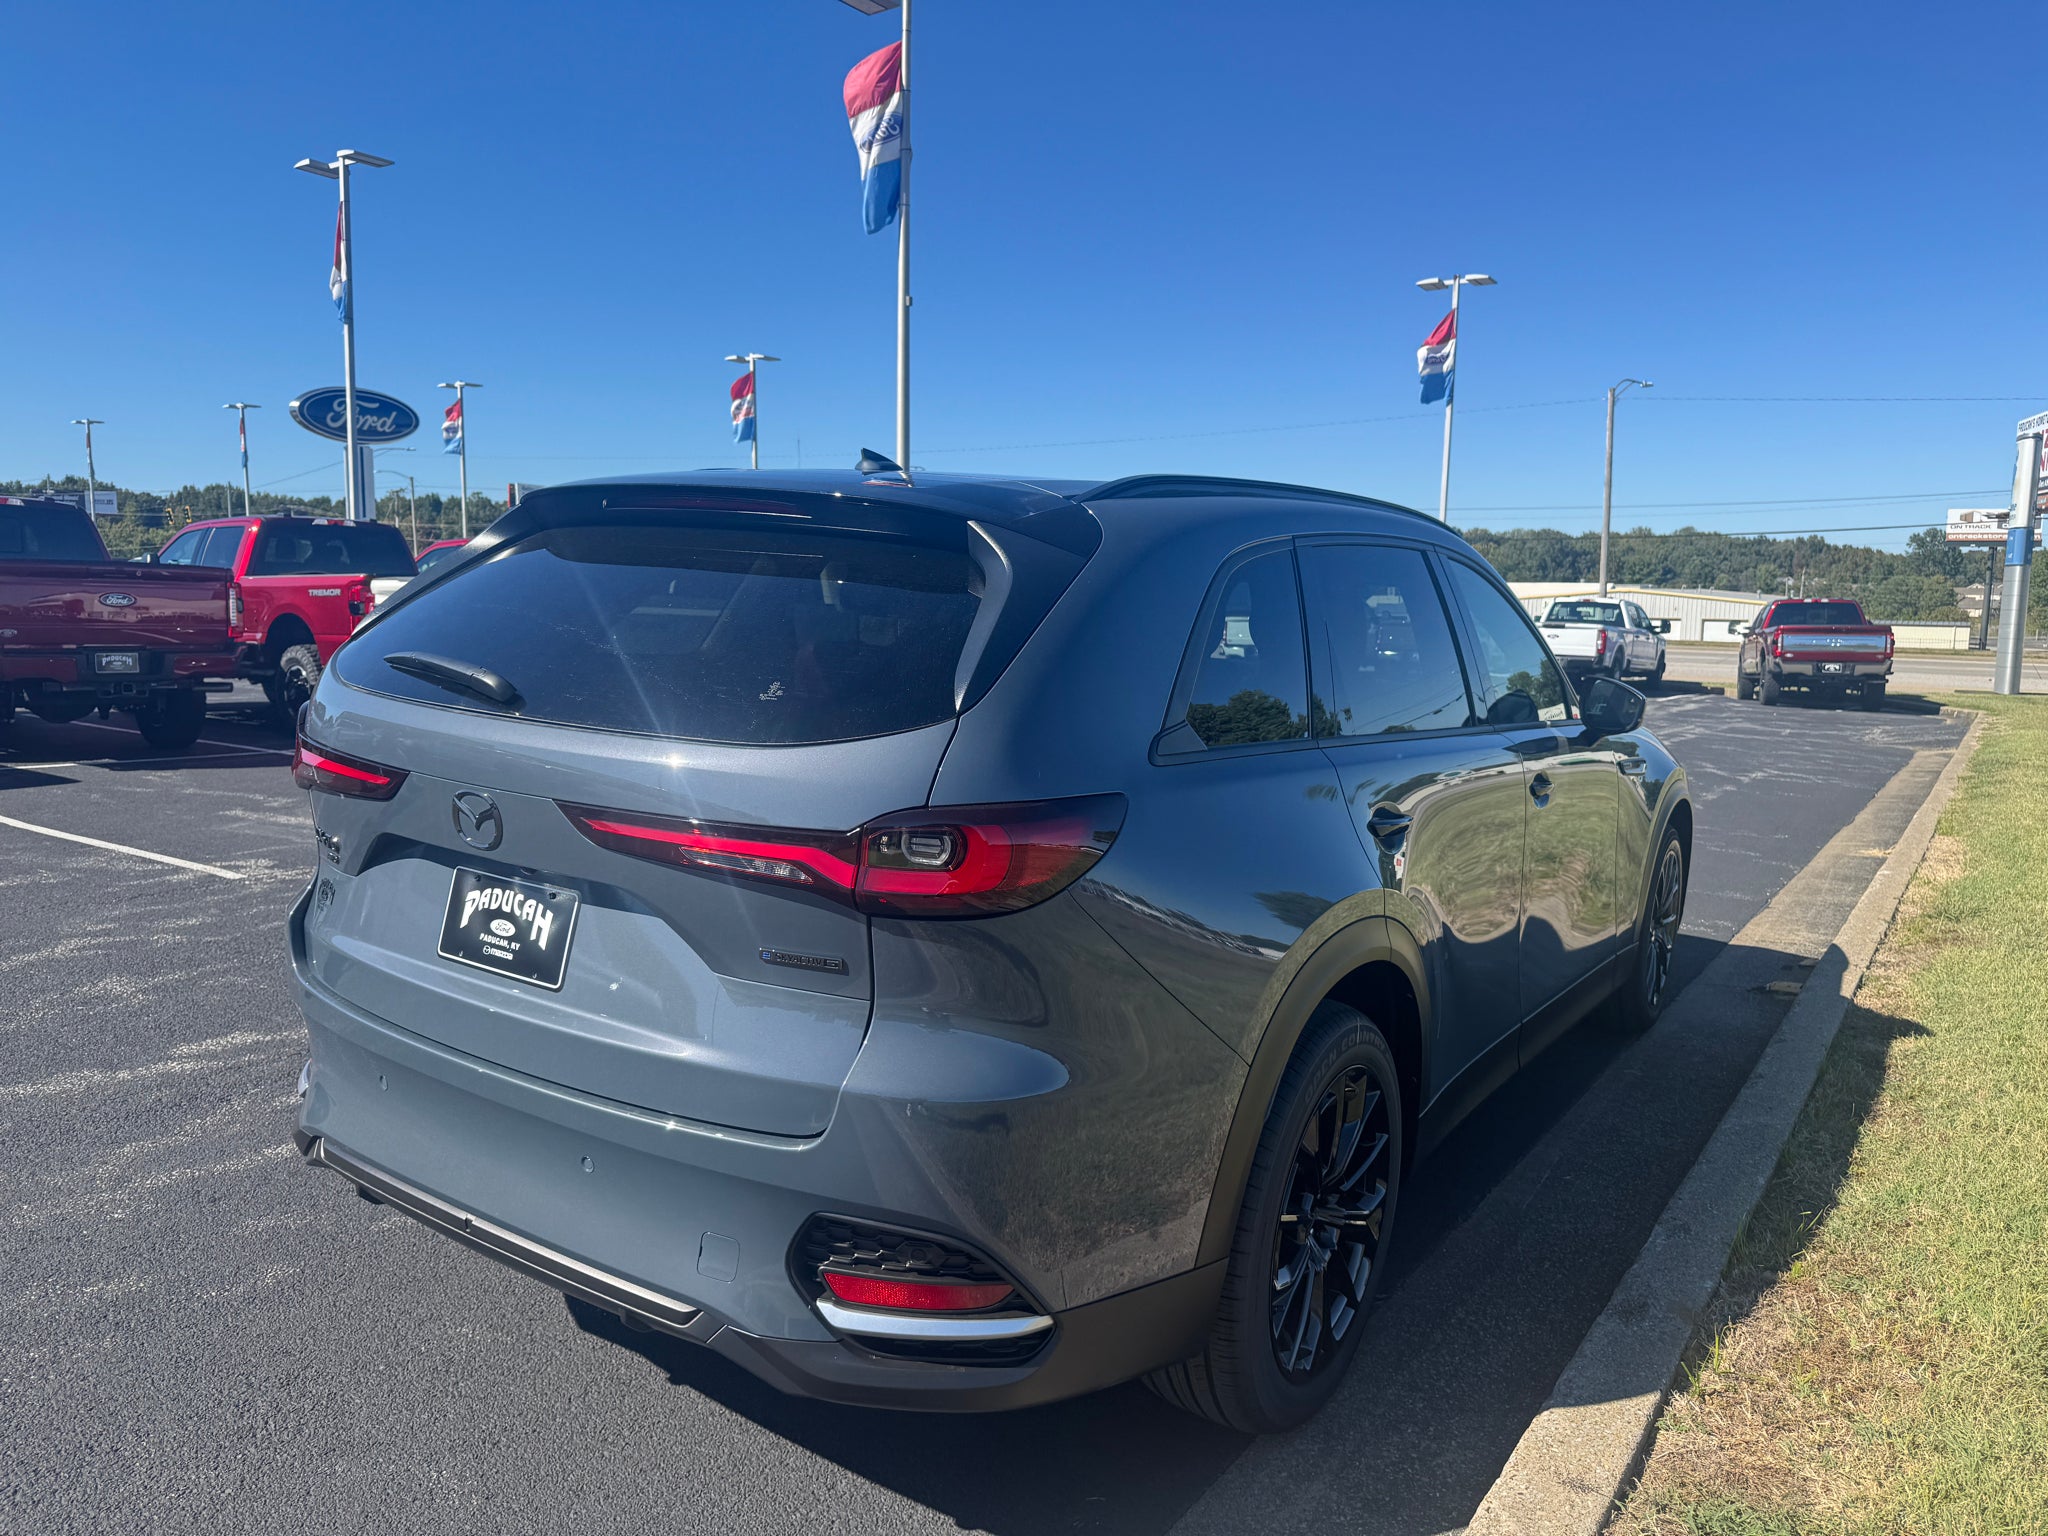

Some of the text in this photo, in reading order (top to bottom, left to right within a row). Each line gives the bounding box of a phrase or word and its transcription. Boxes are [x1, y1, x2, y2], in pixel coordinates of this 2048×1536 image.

[106, 594, 129, 605] Ford
[308, 588, 341, 597] TREMOR
[459, 887, 554, 951] PADUCAH
[479, 932, 521, 951] PADUCAH, KY
